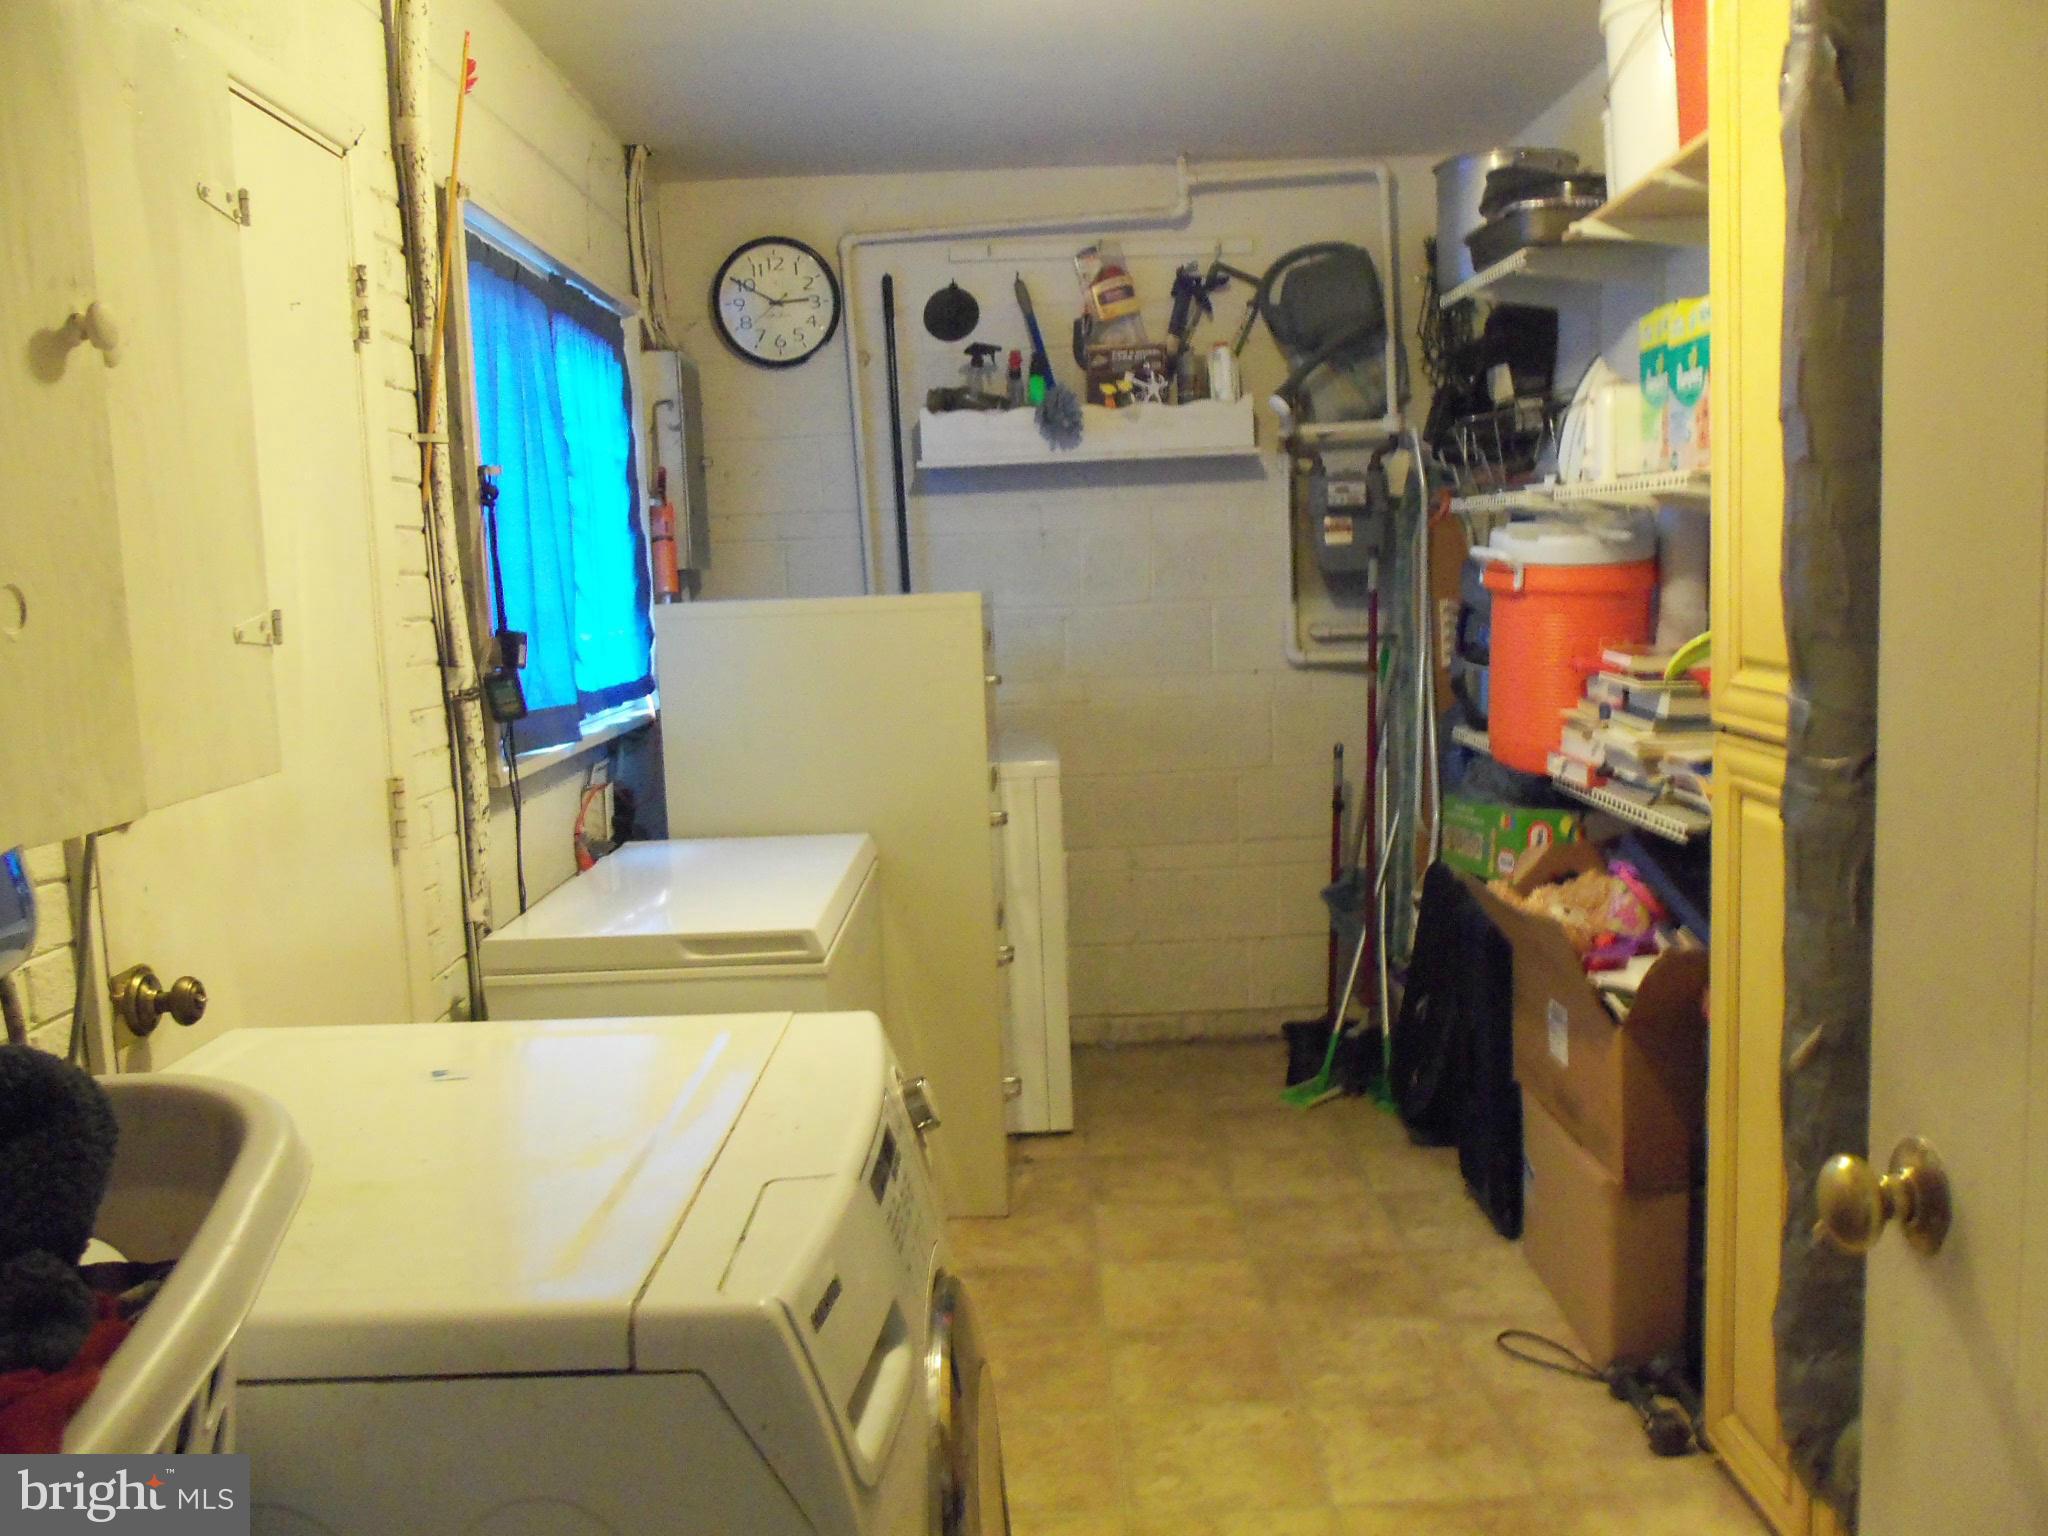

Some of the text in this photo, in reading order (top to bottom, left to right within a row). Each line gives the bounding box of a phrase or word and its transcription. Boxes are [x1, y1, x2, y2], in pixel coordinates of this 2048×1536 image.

[751, 263, 762, 278] 11
[767, 257, 784, 271] 12
[803, 276, 814, 290] 2
[733, 298, 745, 312] 9
[808, 294, 821, 309] 3
[740, 315, 753, 330] 8
[806, 314, 817, 328] 4
[774, 334, 787, 348] 6
[793, 328, 805, 342] 5
